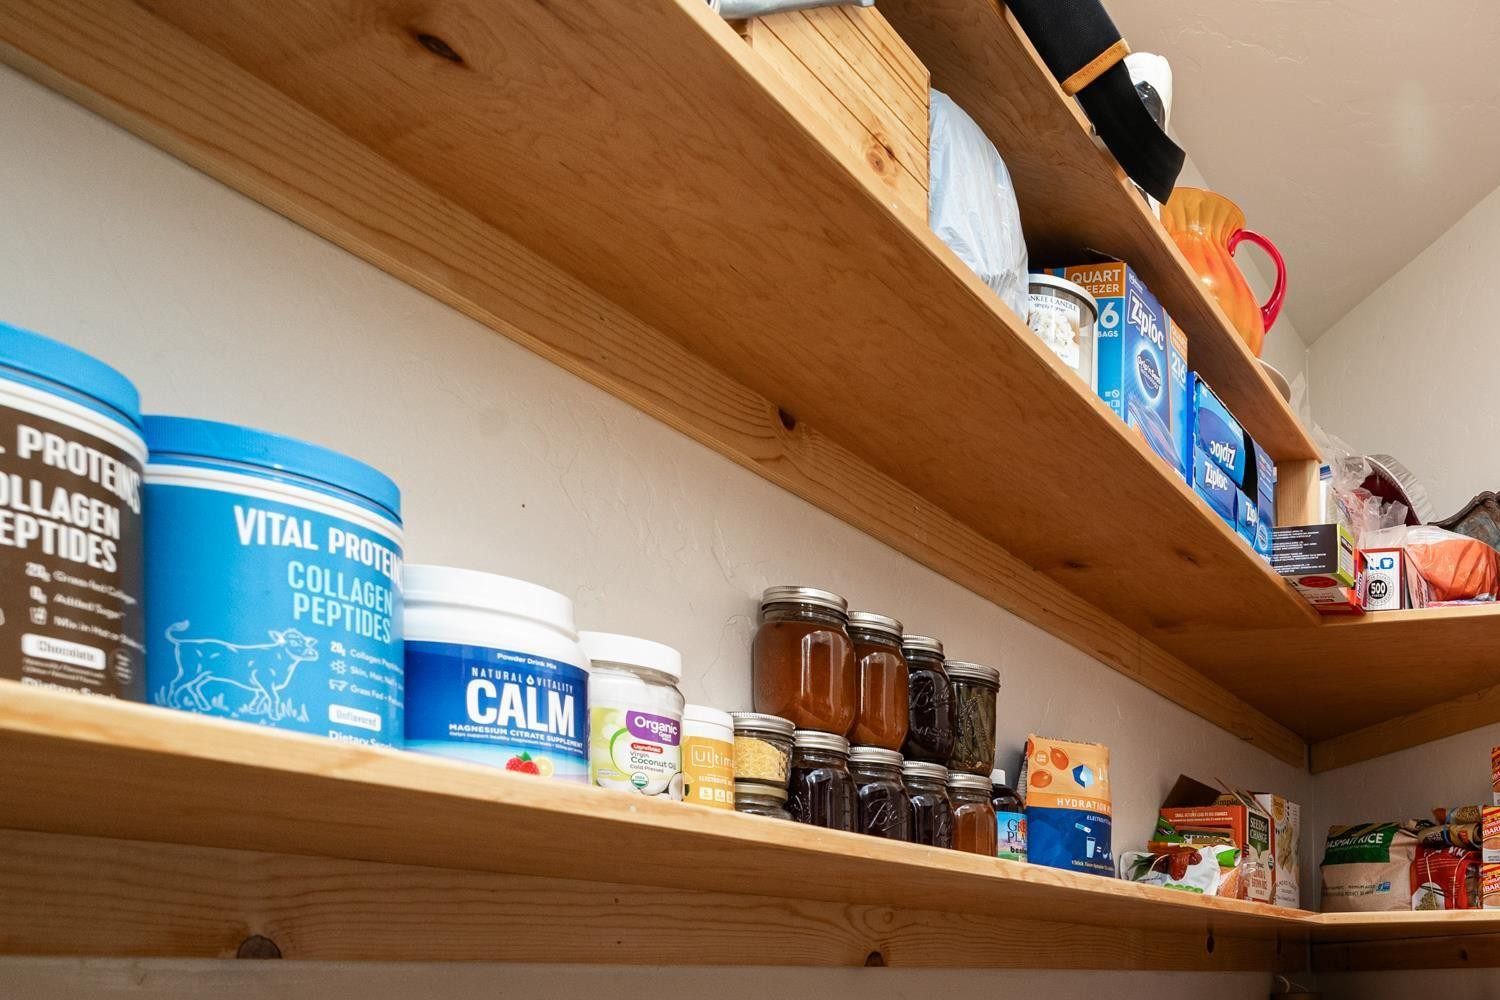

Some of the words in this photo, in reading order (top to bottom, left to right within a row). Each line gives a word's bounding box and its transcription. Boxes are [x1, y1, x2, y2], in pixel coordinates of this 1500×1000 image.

[1071, 269, 1121, 284] QUART
[1083, 284, 1119, 294] EEZER
[1130, 294, 1164, 351] Ziploc
[1210, 440, 1236, 471] Ziploc
[17, 424, 141, 515] PROTEINS
[1204, 461, 1229, 491] Ziploc
[0, 471, 121, 541] OLLAGEN
[0, 510, 118, 573] EPTIDES
[233, 504, 320, 551] VITAL
[328, 526, 403, 590] PROTEIN
[287, 560, 394, 618] COLLAGEN
[1370, 583, 1386, 595] 500
[293, 592, 391, 645] PEPTIDES
[497, 653, 526, 664] Powder
[527, 657, 546, 668] Drink
[472, 667, 523, 684] NATURAL
[537, 677, 574, 694] VITALITY
[466, 678, 576, 739] CALM
[449, 723, 508, 736] MAGNESIUM
[509, 729, 545, 741] CITRATE
[546, 735, 584, 750] SUPPLEMENT
[634, 715, 678, 736] Organic
[630, 751, 650, 761] Virgin
[630, 756, 667, 768] Coconut
[695, 749, 736, 770] Ultim
[1057, 798, 1105, 812] HYDRATION
[1250, 817, 1264, 832] SEEDS
[1250, 830, 1268, 844] CHANGE
[1328, 836, 1357, 849] ASMATI
[1358, 832, 1385, 845] RICE
